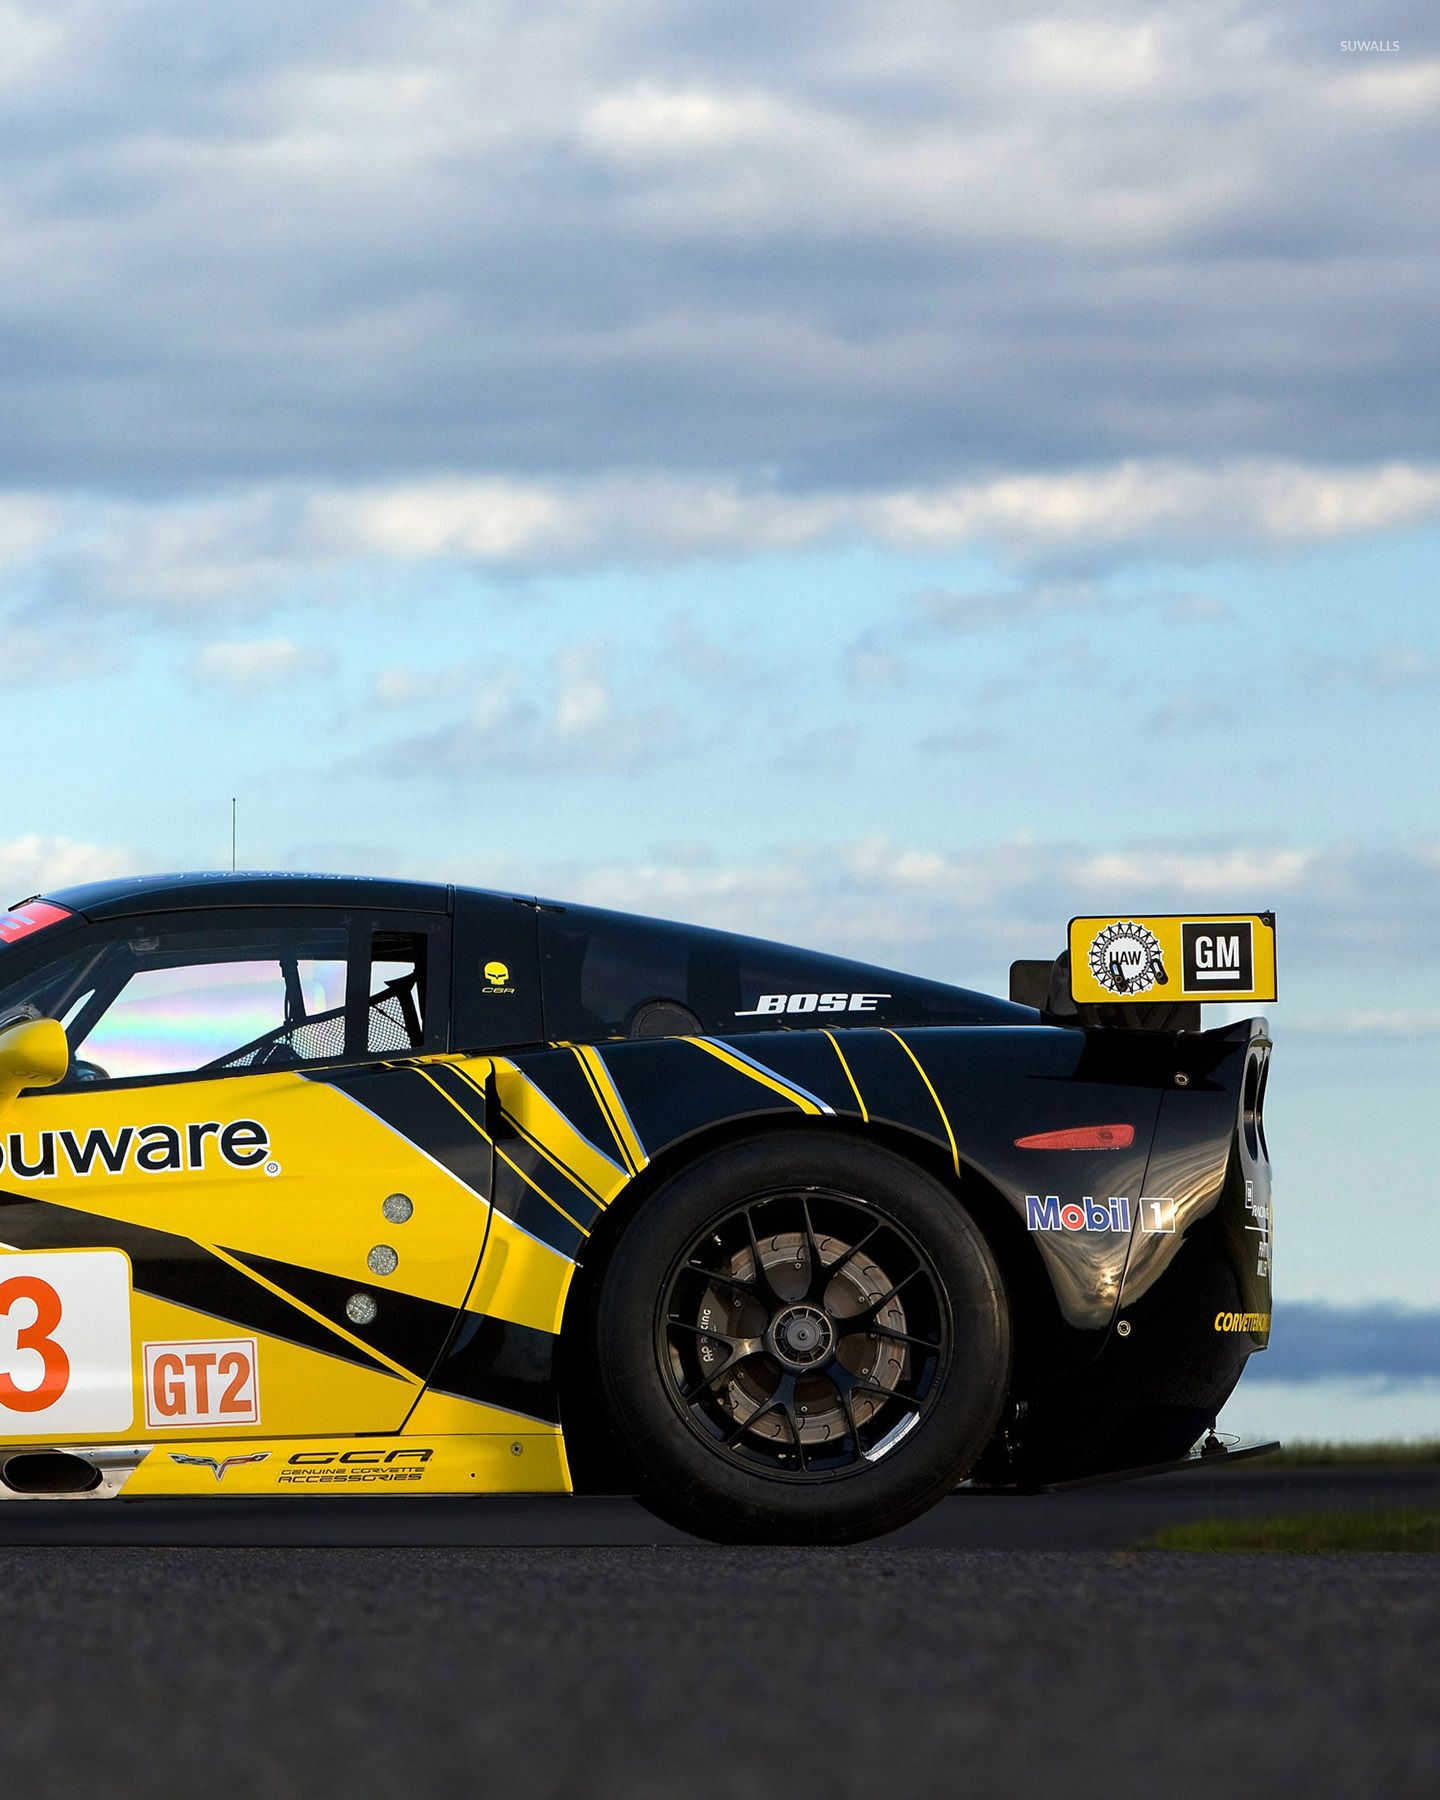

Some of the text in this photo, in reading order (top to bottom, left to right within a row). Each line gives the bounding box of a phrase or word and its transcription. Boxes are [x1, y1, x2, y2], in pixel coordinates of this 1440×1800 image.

[1195, 935, 1241, 969] GM
[735, 993, 892, 1016] BOSE
[1025, 1195, 1132, 1232] Mobil
[153, 1352, 253, 1417] GT2
[288, 1449, 434, 1465] GCA
[278, 1474, 423, 1484] ACCESSORIES
[281, 1468, 347, 1476] GENUINE
